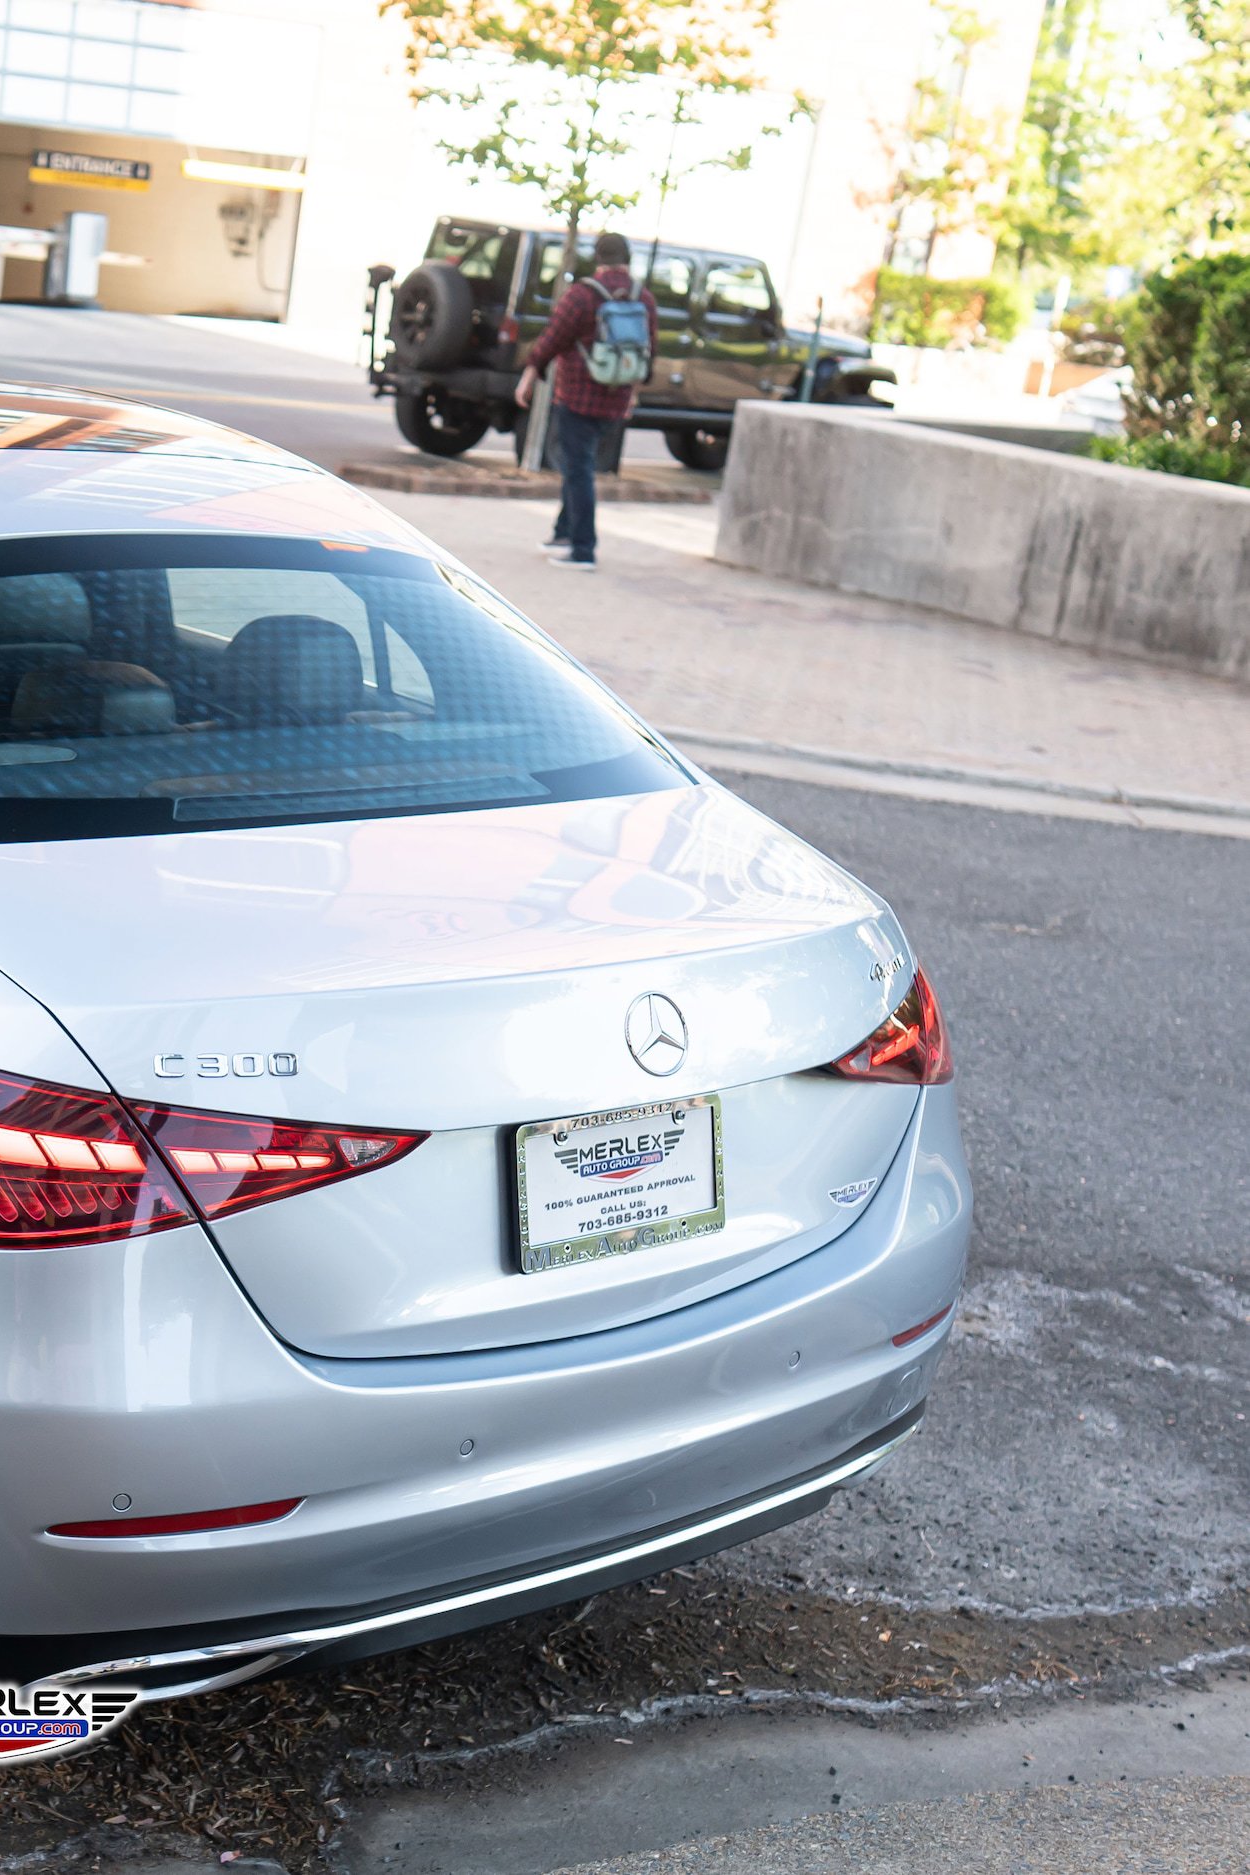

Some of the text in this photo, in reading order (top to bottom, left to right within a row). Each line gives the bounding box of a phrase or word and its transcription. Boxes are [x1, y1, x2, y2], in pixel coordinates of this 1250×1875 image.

[50, 151, 133, 177] ENTRANCE
[153, 1053, 300, 1078] C 300
[570, 1102, 674, 1130] 703-685-9312
[579, 1132, 663, 1164] MERLEX
[582, 1152, 662, 1175] AUTO GROUP.com
[544, 1174, 696, 1211] 100% GUARANTEED APPROVAL
[578, 1204, 669, 1233] 703-685-9312
[600, 1199, 647, 1215] CALL US:
